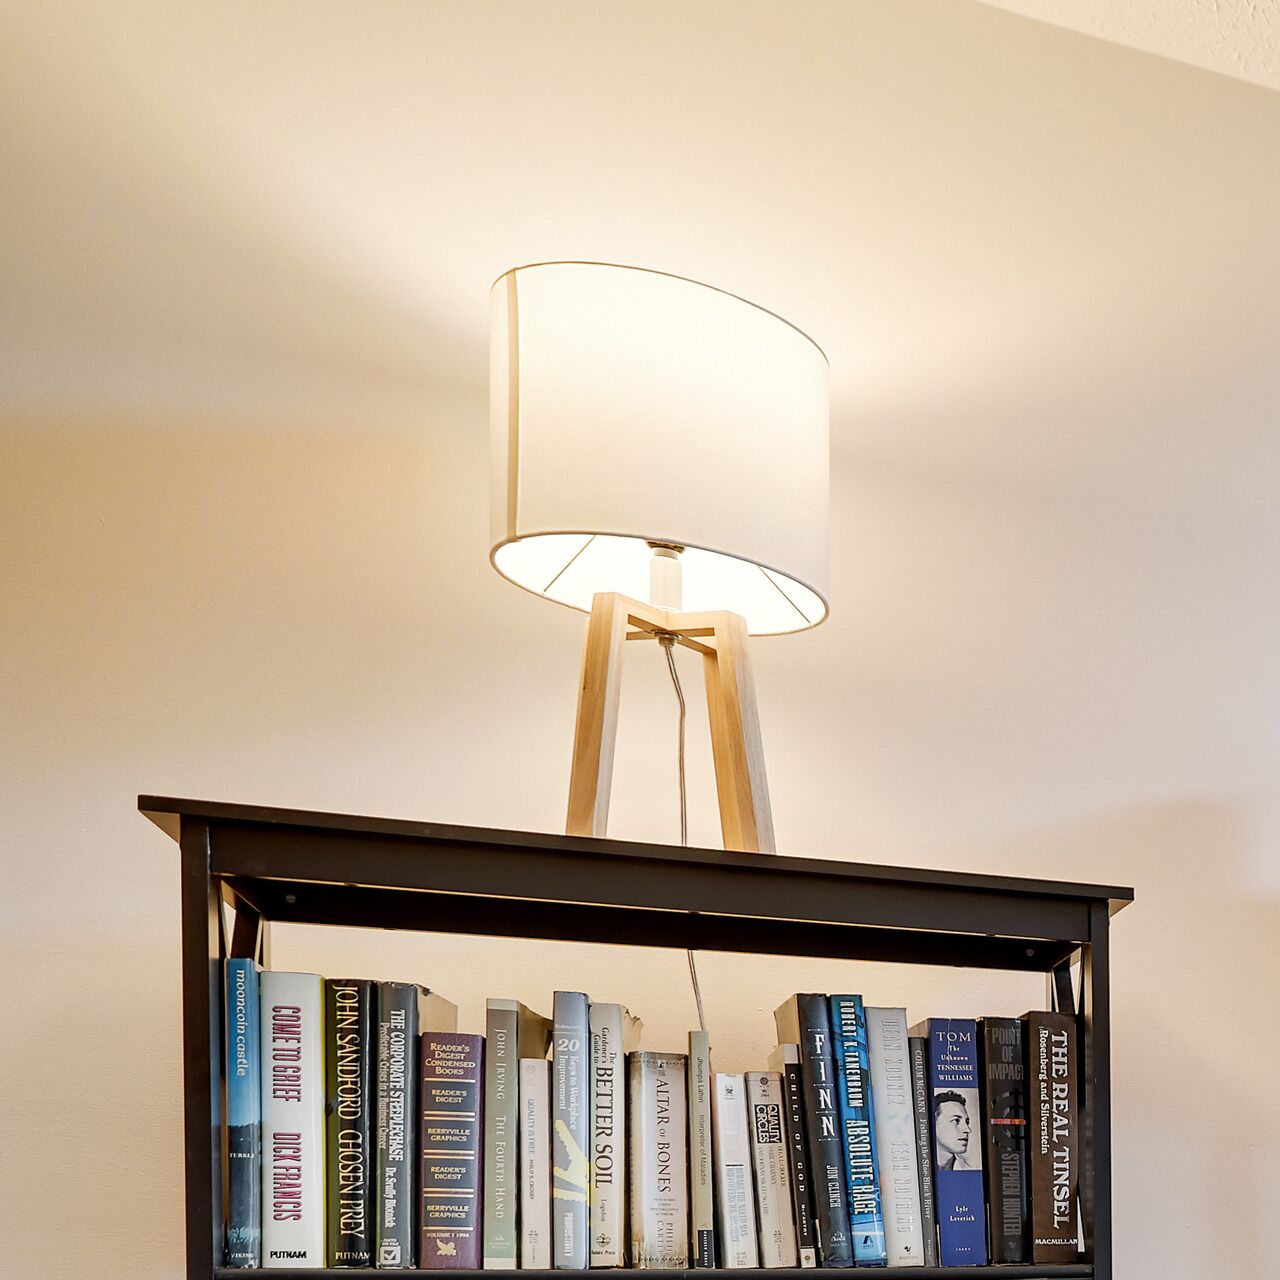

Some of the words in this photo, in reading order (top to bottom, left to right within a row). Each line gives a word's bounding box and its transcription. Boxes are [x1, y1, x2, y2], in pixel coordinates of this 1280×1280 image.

[236, 970, 250, 1033] mooncoin
[332, 986, 359, 1028] JOHN
[390, 1010, 405, 1028] THE
[272, 1005, 301, 1043] COME
[936, 1032, 971, 1042] TOM
[991, 1027, 1021, 1046] POINT
[236, 1037, 250, 1077] castle
[272, 1046, 301, 1062] TO
[389, 1031, 405, 1089] CORPORATE
[429, 1043, 470, 1054] READER'S
[434, 1051, 466, 1061] DIGEST
[495, 1029, 507, 1057] JOHN
[1001, 1045, 1014, 1063] OF
[1038, 1028, 1049, 1080] Rosenberg
[1051, 1030, 1068, 1078] THE
[336, 1034, 362, 1119] SANDFORD
[425, 1059, 476, 1070] CONDENSED
[434, 1066, 465, 1076] BOOKS
[495, 1061, 507, 1100] IRVING
[936, 1064, 974, 1072] TENNESSEE
[988, 1063, 1025, 1081] IMPACT
[272, 1065, 302, 1103] GRIEF
[431, 1088, 467, 1098] READER'S
[435, 1096, 463, 1104] DIGEST
[595, 1066, 614, 1138] BETTER
[1040, 1081, 1049, 1099] and
[388, 1091, 405, 1161] STEEPLECHASE
[494, 1115, 507, 1135] THE
[756, 1104, 769, 1144] CIRCLES
[768, 1104, 780, 1144] QUALITY
[1040, 1100, 1050, 1155] Silverstein
[1052, 1081, 1070, 1143] REAL
[272, 1132, 302, 1162] DICK
[427, 1127, 471, 1136] BERRYVILLE
[430, 1134, 467, 1143] GRAPHICS
[338, 1129, 364, 1195] CHOSEN
[494, 1140, 507, 1183] FOURTH
[594, 1142, 614, 1189] SOIL
[846, 1120, 875, 1182] ABSOLUTE
[1000, 1152, 1020, 1189] STEPHEN
[1052, 1146, 1071, 1230] TINSEL
[273, 1165, 302, 1221] FRANCIS
[494, 1186, 506, 1219] HAND
[851, 1184, 877, 1215] RAGE
[339, 1198, 365, 1239] PREY
[1002, 1191, 1021, 1237] HUNTER
[270, 1251, 307, 1259] PUTNAM
[335, 1251, 371, 1260] PUTNAM
